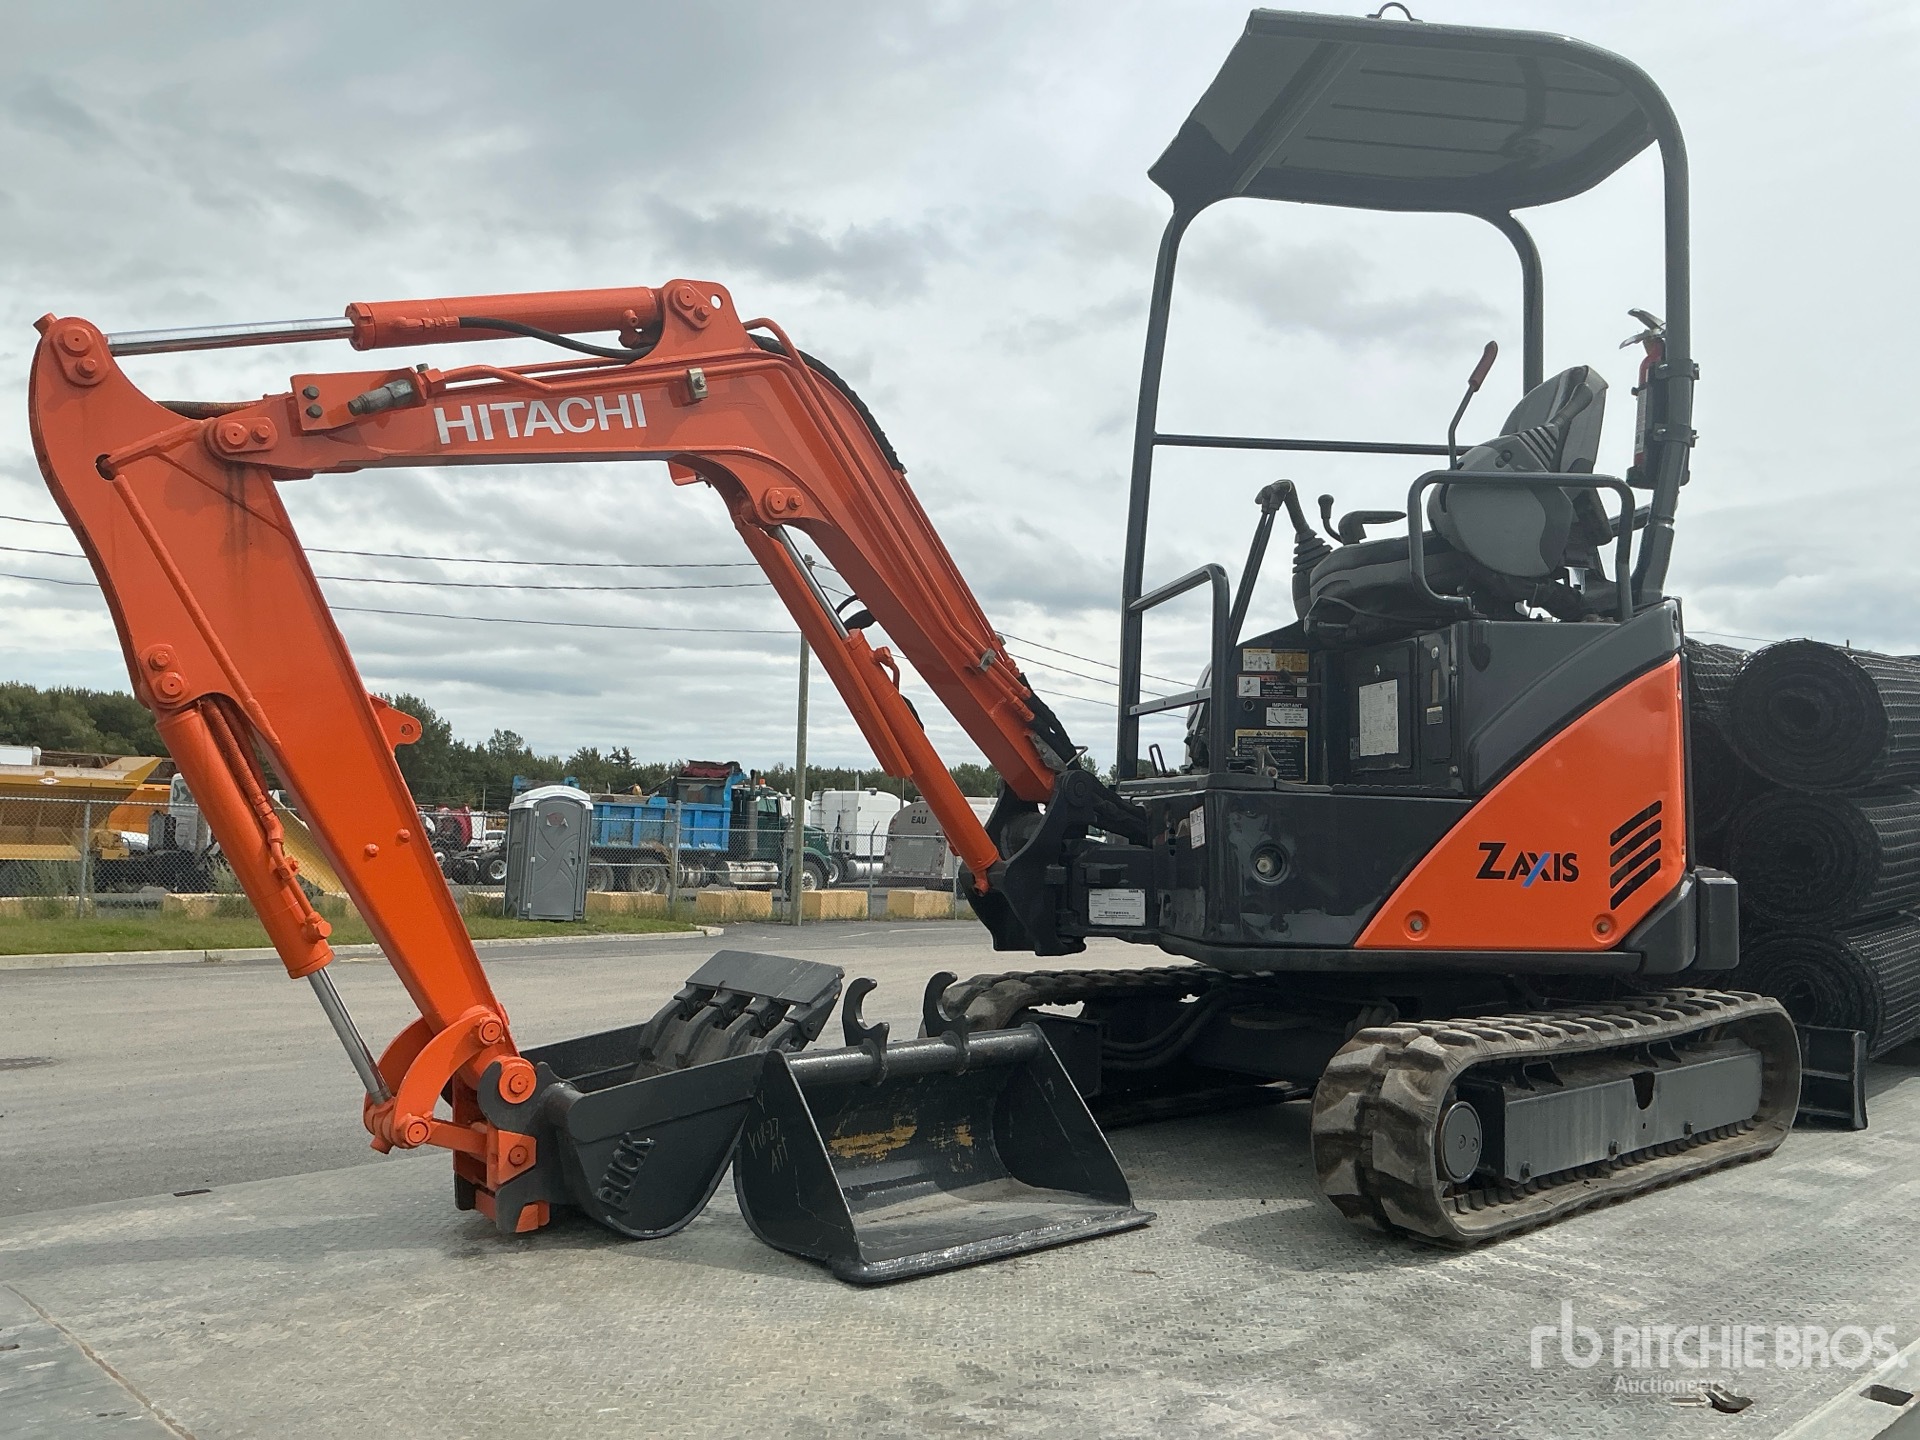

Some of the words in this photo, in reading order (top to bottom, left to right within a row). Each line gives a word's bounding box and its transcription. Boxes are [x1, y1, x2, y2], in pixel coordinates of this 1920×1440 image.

[434, 393, 647, 444] HITACHI
[911, 816, 927, 824] EAU
[1475, 842, 1580, 888] ZAXIS
[595, 1132, 655, 1213] BUCK
